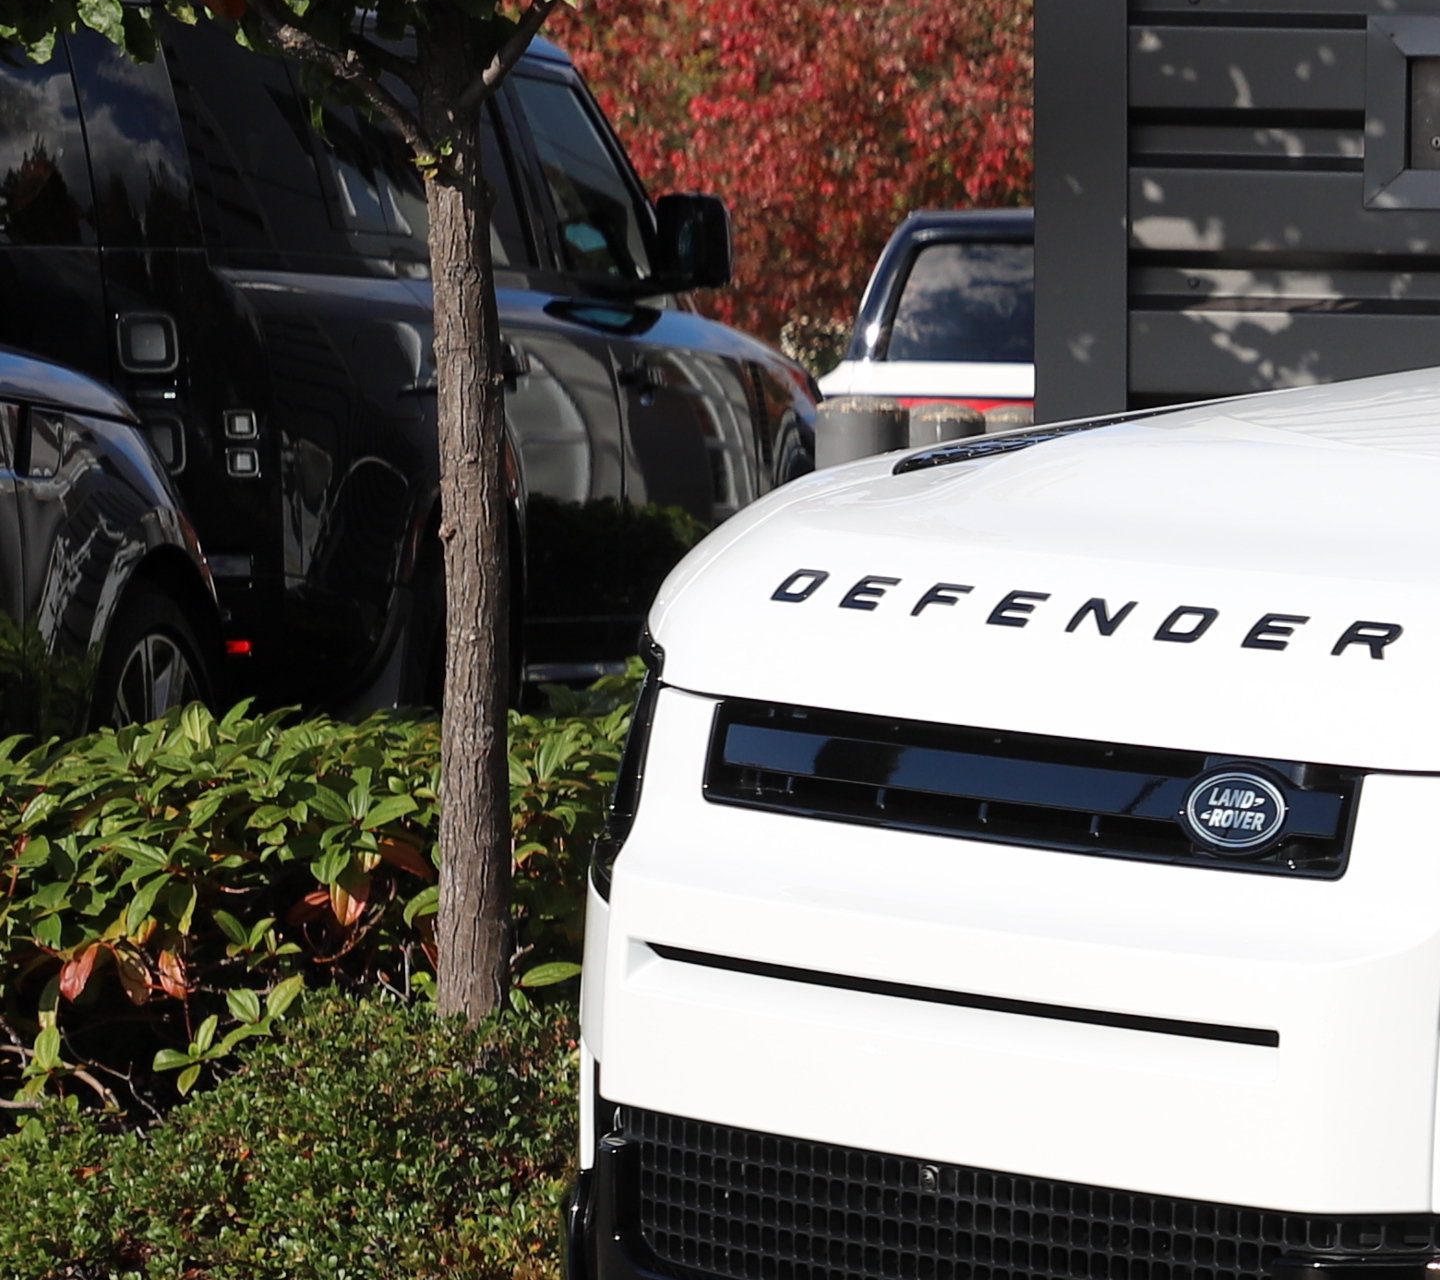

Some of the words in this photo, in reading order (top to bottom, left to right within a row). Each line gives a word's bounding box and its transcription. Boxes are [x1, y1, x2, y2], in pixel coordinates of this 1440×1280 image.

[770, 567, 1404, 661] DEFENDER
[1208, 787, 1255, 809] LAND
[1208, 808, 1266, 832] ROVER
